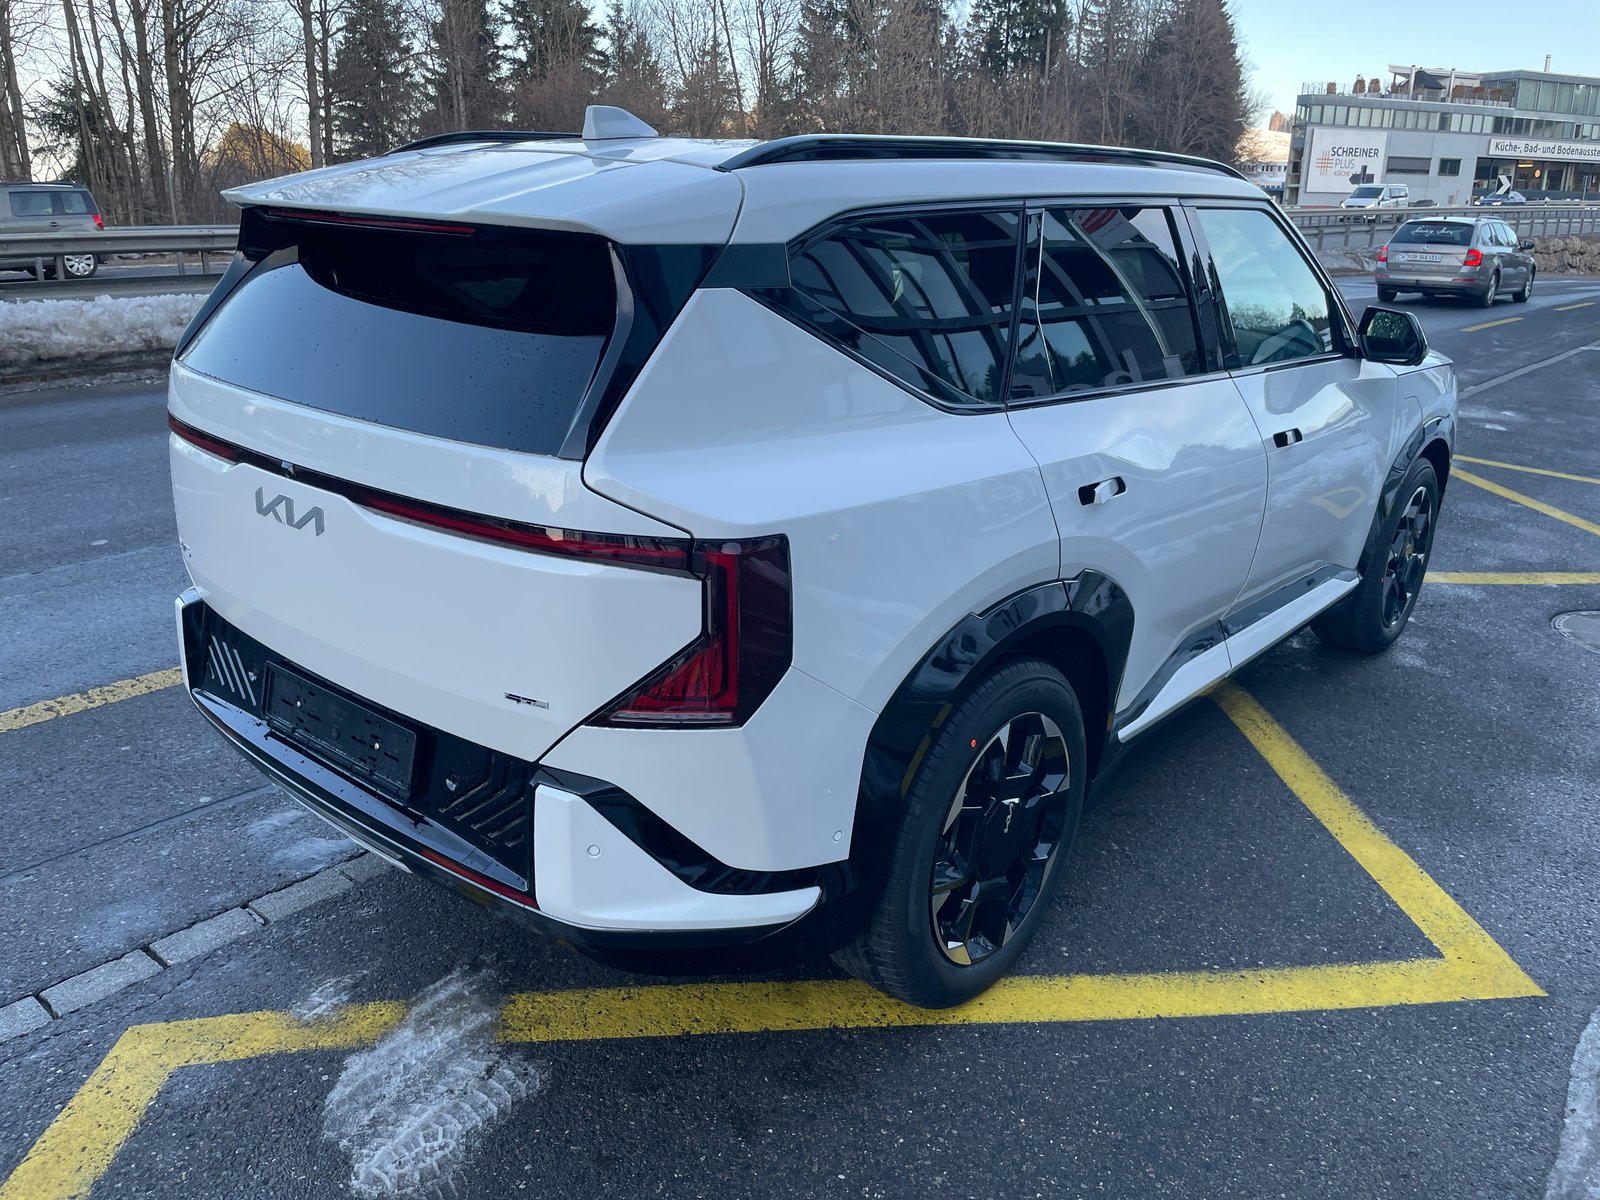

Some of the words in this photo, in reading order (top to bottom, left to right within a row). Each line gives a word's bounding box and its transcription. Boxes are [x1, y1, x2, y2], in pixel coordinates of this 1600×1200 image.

[1331, 146, 1379, 158] SCHREINER
[1495, 141, 1522, 153] Küche-,
[1524, 143, 1540, 153] Bad-
[1542, 145, 1557, 154] und
[1334, 158, 1355, 169] PLUS
[255, 486, 325, 537] KIA
